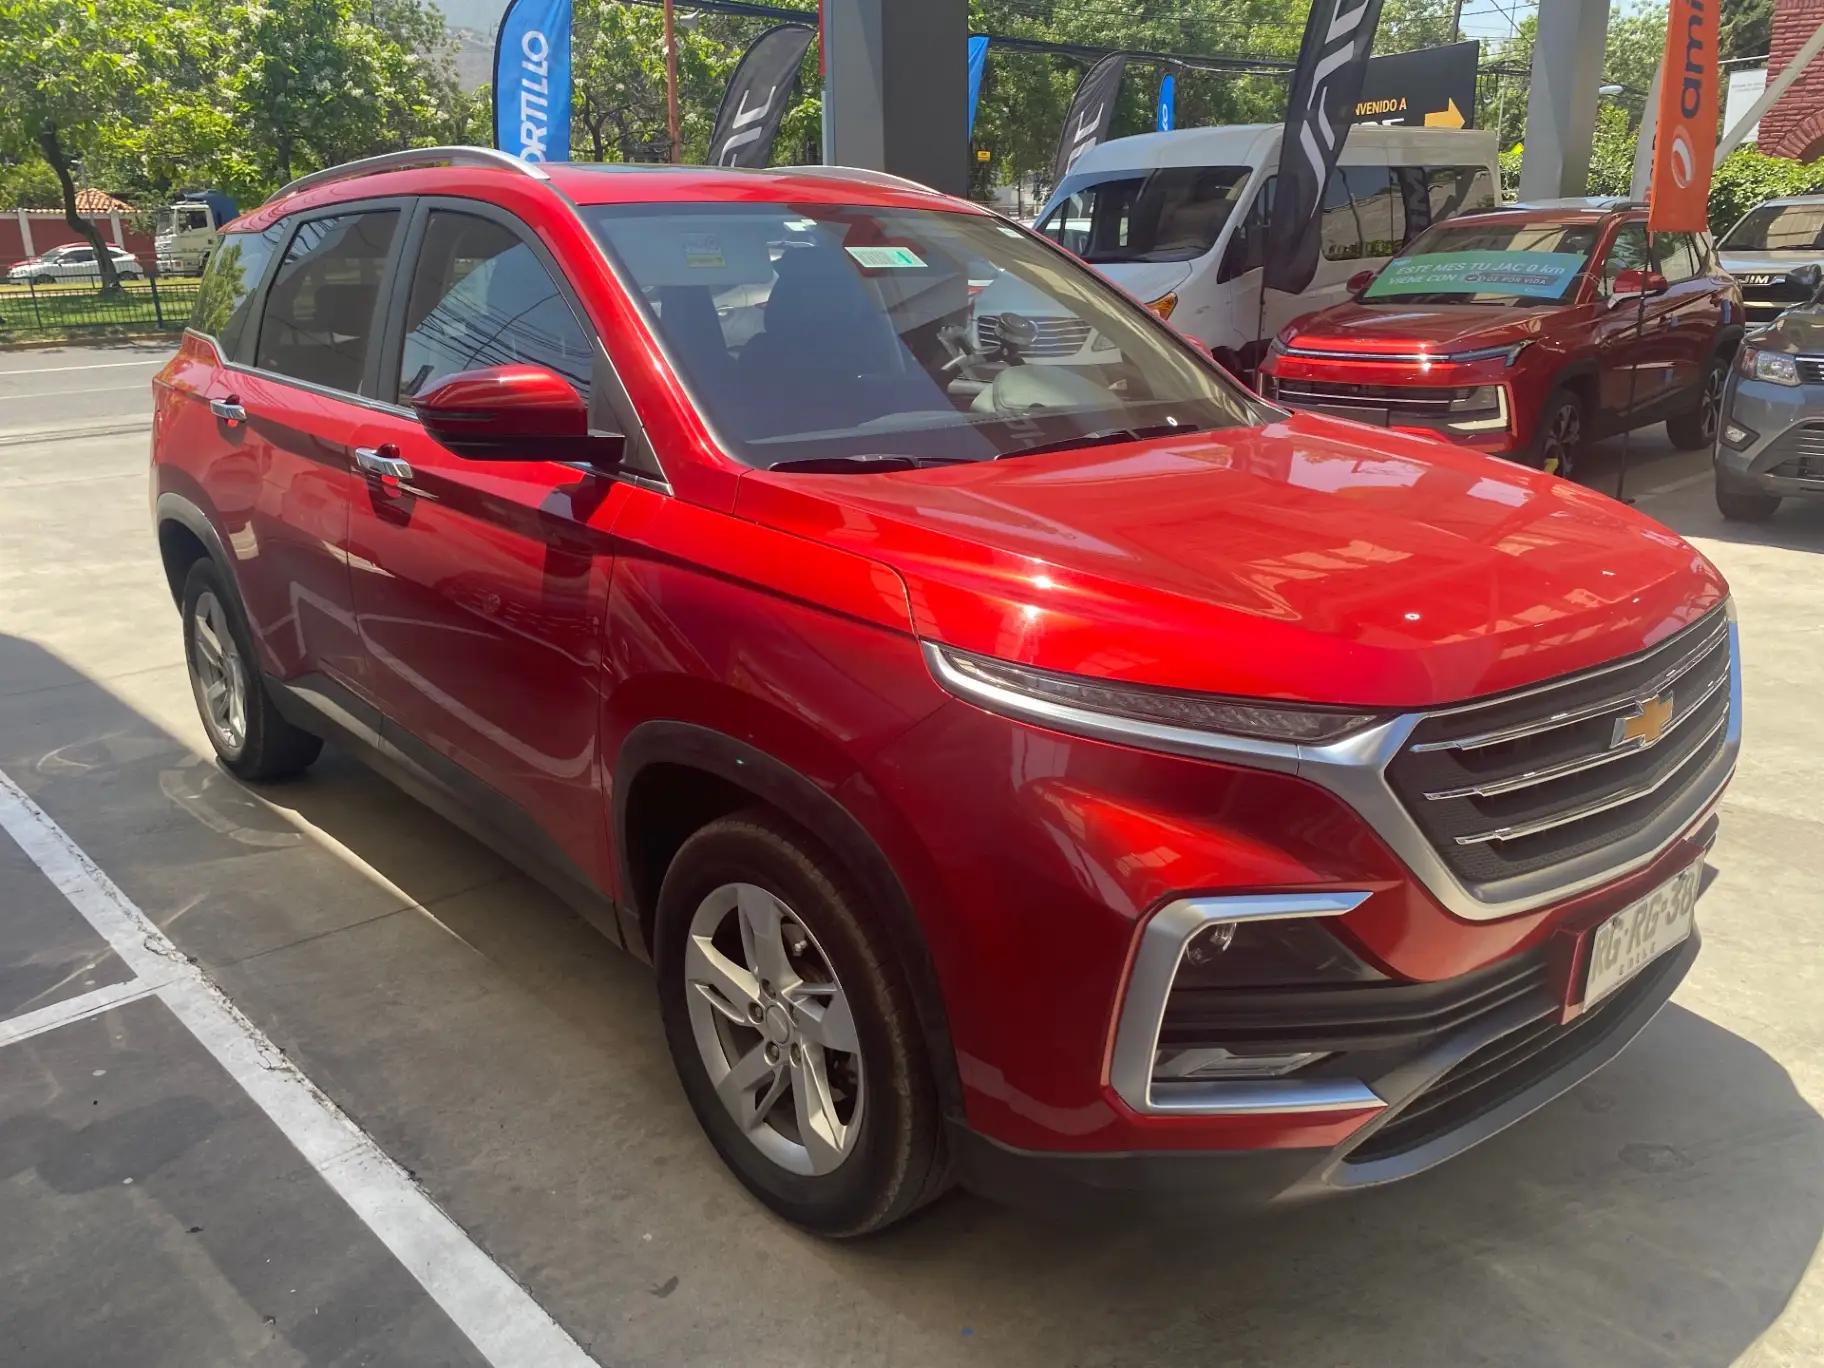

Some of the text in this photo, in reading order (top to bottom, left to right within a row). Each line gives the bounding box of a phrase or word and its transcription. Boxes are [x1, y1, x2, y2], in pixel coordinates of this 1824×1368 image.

[1398, 97, 1407, 111] A
[1470, 262, 1492, 271] TU
[1492, 262, 1523, 272] JAC
